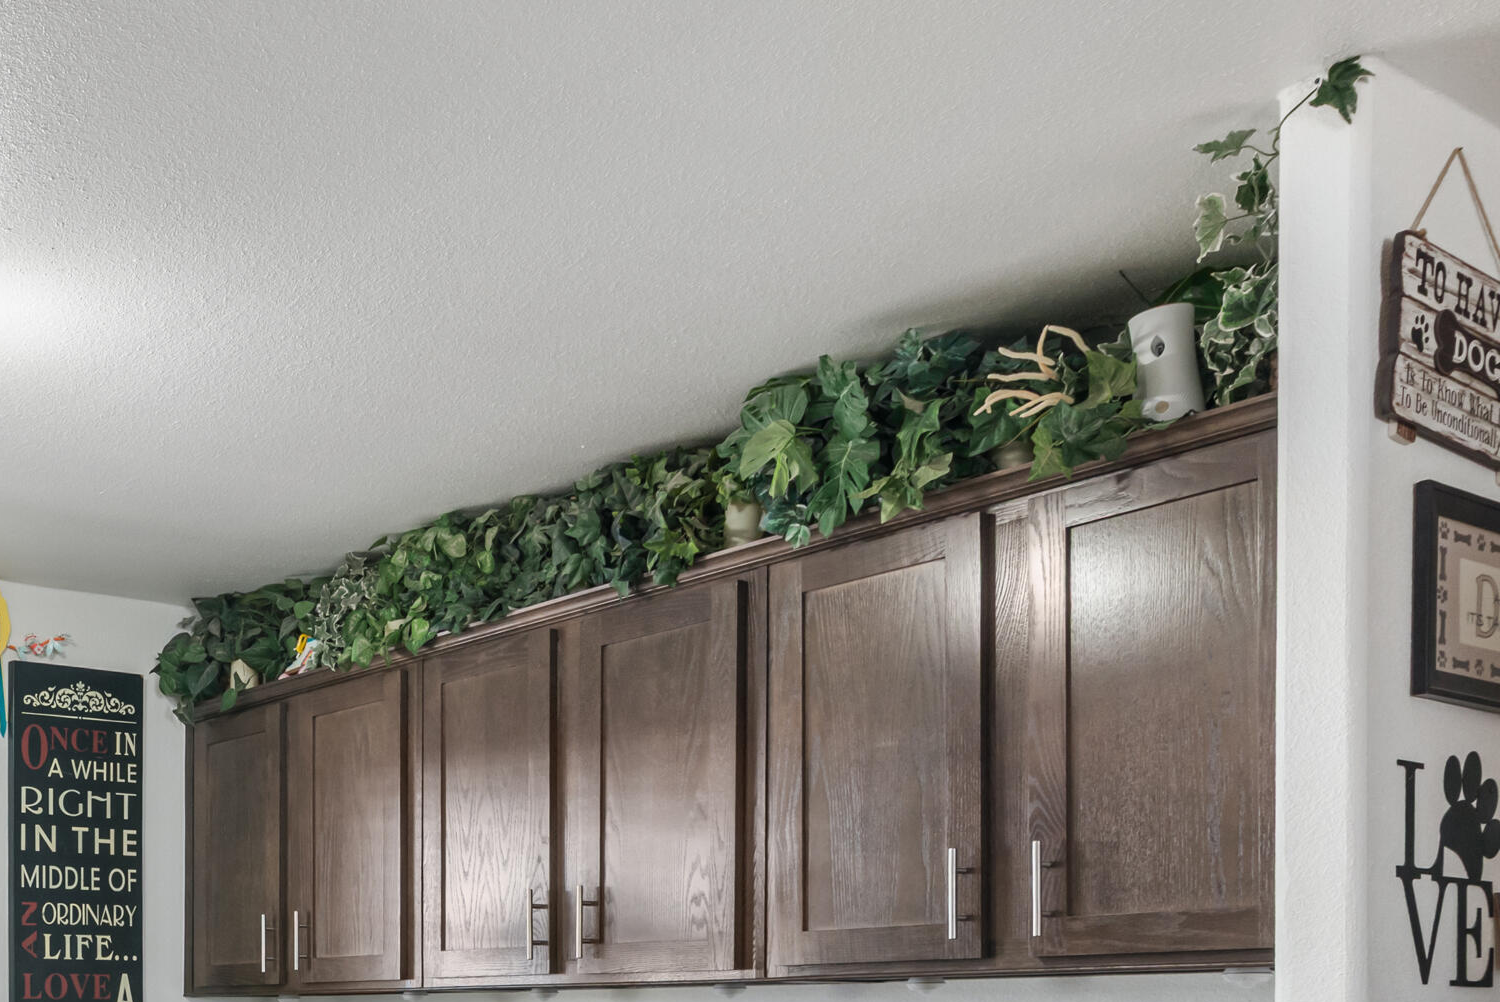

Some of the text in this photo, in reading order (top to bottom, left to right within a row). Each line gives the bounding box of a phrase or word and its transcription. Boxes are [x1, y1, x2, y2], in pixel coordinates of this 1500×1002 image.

[1415, 247, 1447, 304] TO
[1401, 385, 1411, 408] To
[1415, 393, 1428, 417] Be
[1422, 370, 1433, 394] To
[1438, 378, 1465, 408] Know
[21, 723, 137, 770] ONCE IN
[47, 757, 137, 784] A WHILE
[20, 786, 137, 820] RIGHT
[20, 823, 137, 857] IN THE
[20, 864, 137, 892] MIDDLE OF
[21, 901, 38, 959] AN
[41, 902, 137, 927] ORDINARY
[43, 933, 138, 961] LIFE...
[22, 972, 112, 1000] LOVE
